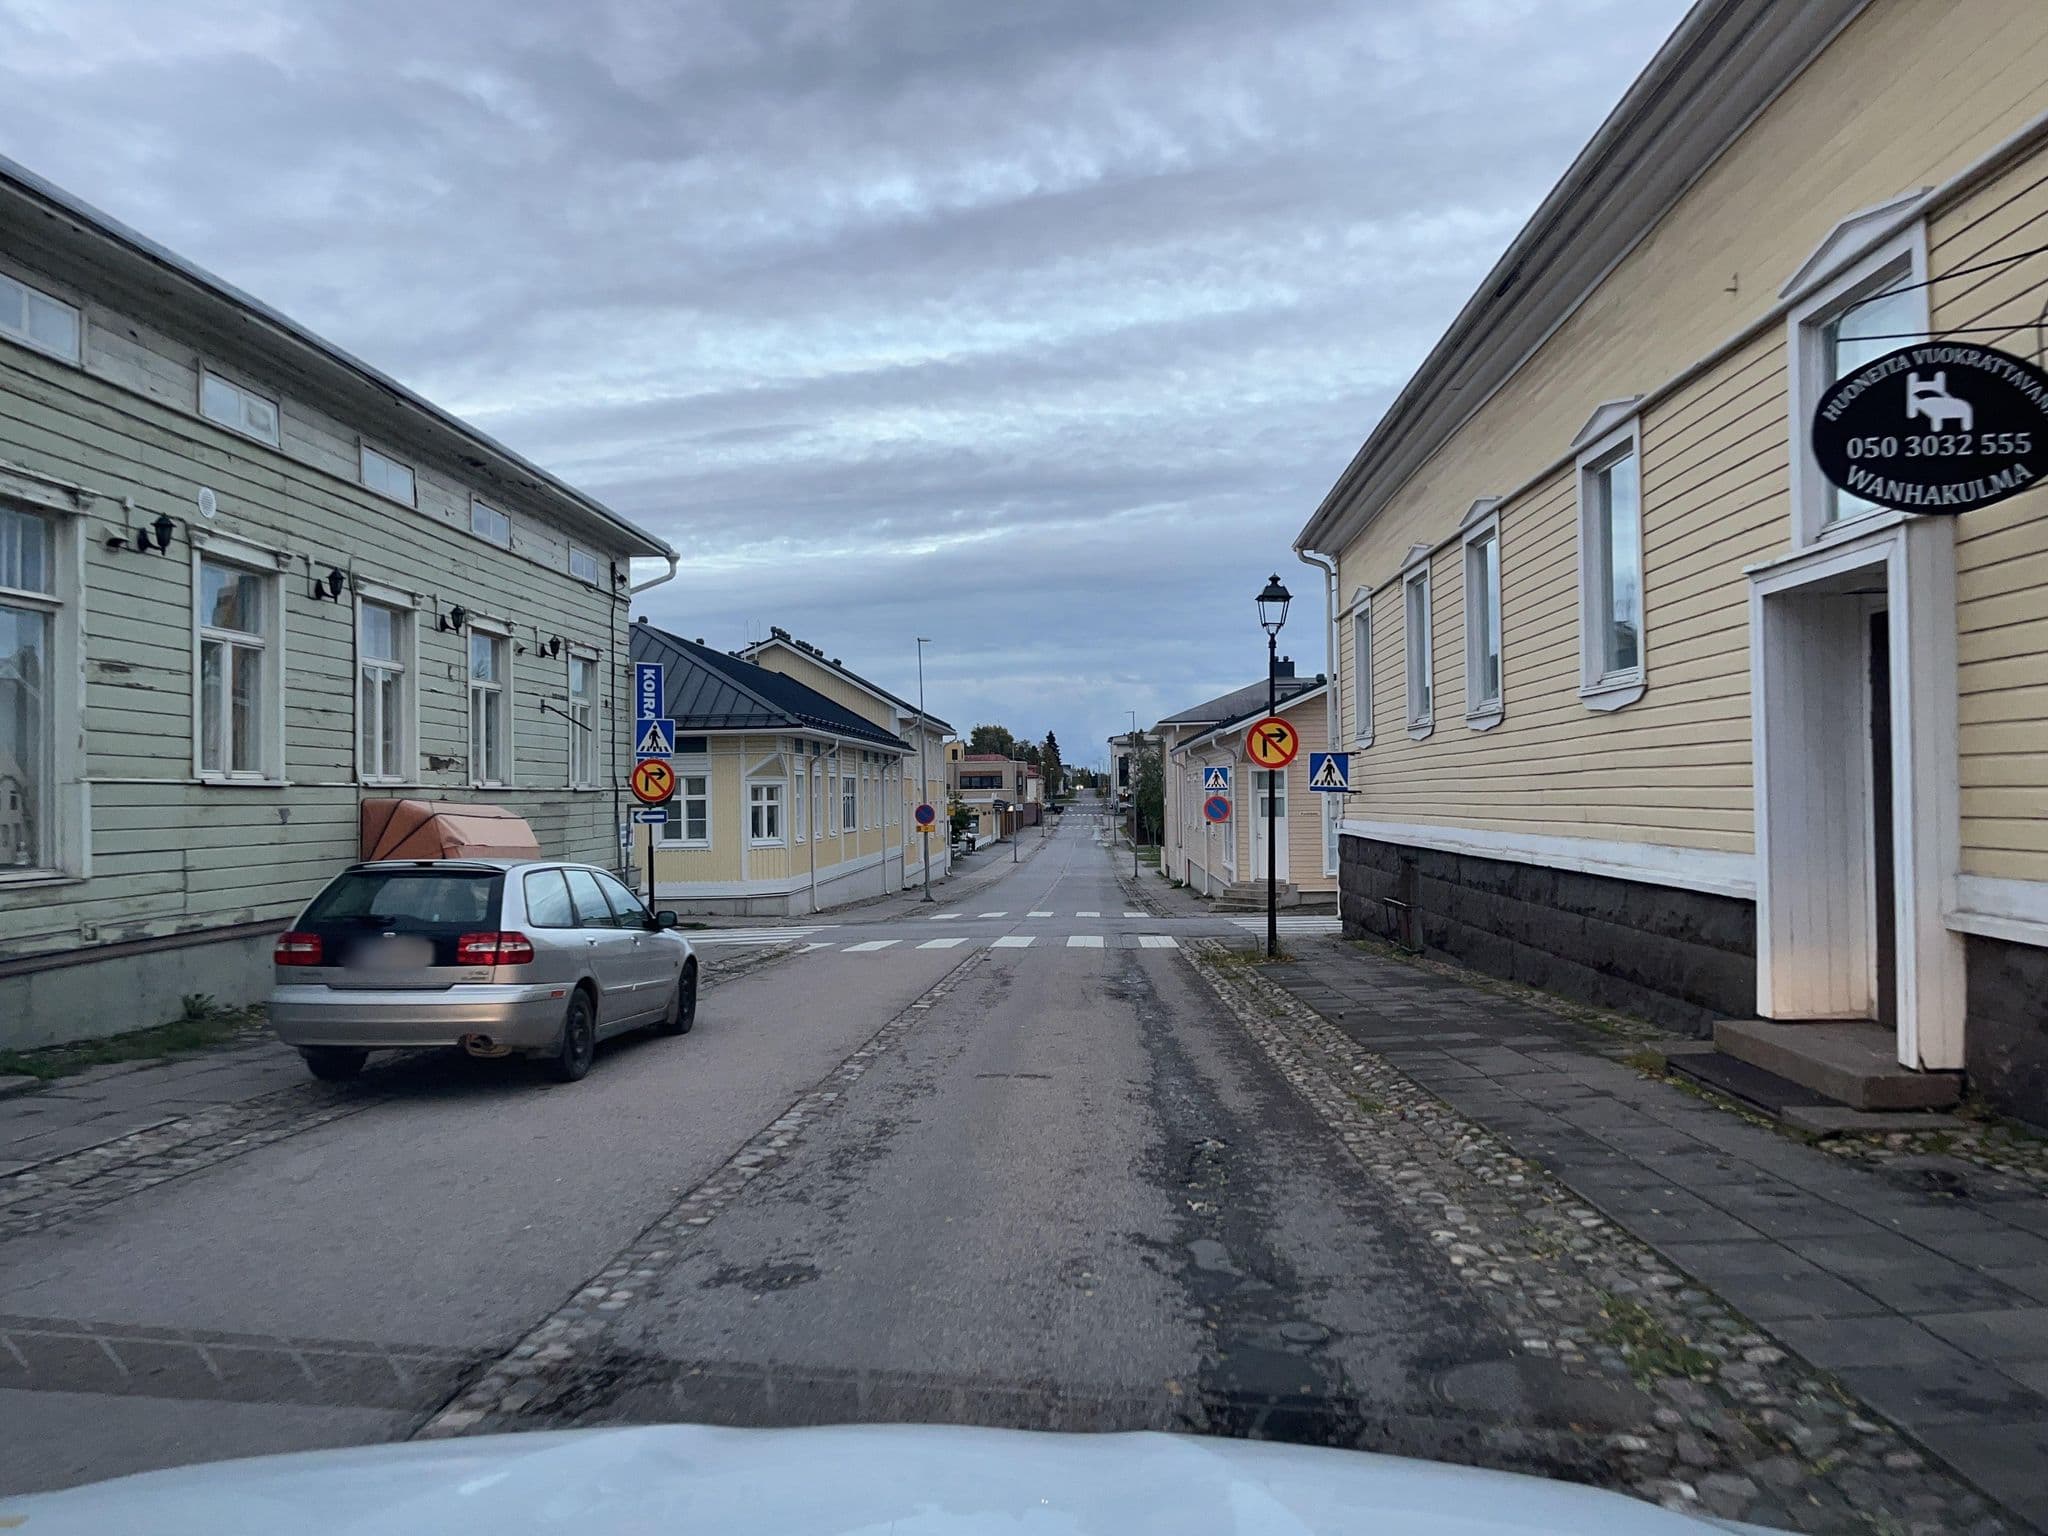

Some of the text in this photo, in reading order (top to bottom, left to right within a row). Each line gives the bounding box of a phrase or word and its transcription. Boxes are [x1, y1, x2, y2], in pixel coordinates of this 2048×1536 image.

[1822, 347, 2048, 421] HUONEITA VUOKRATTAVAN
[1846, 432, 2032, 459] 050 3032 555
[1847, 462, 2034, 506] WANHAKULMA
